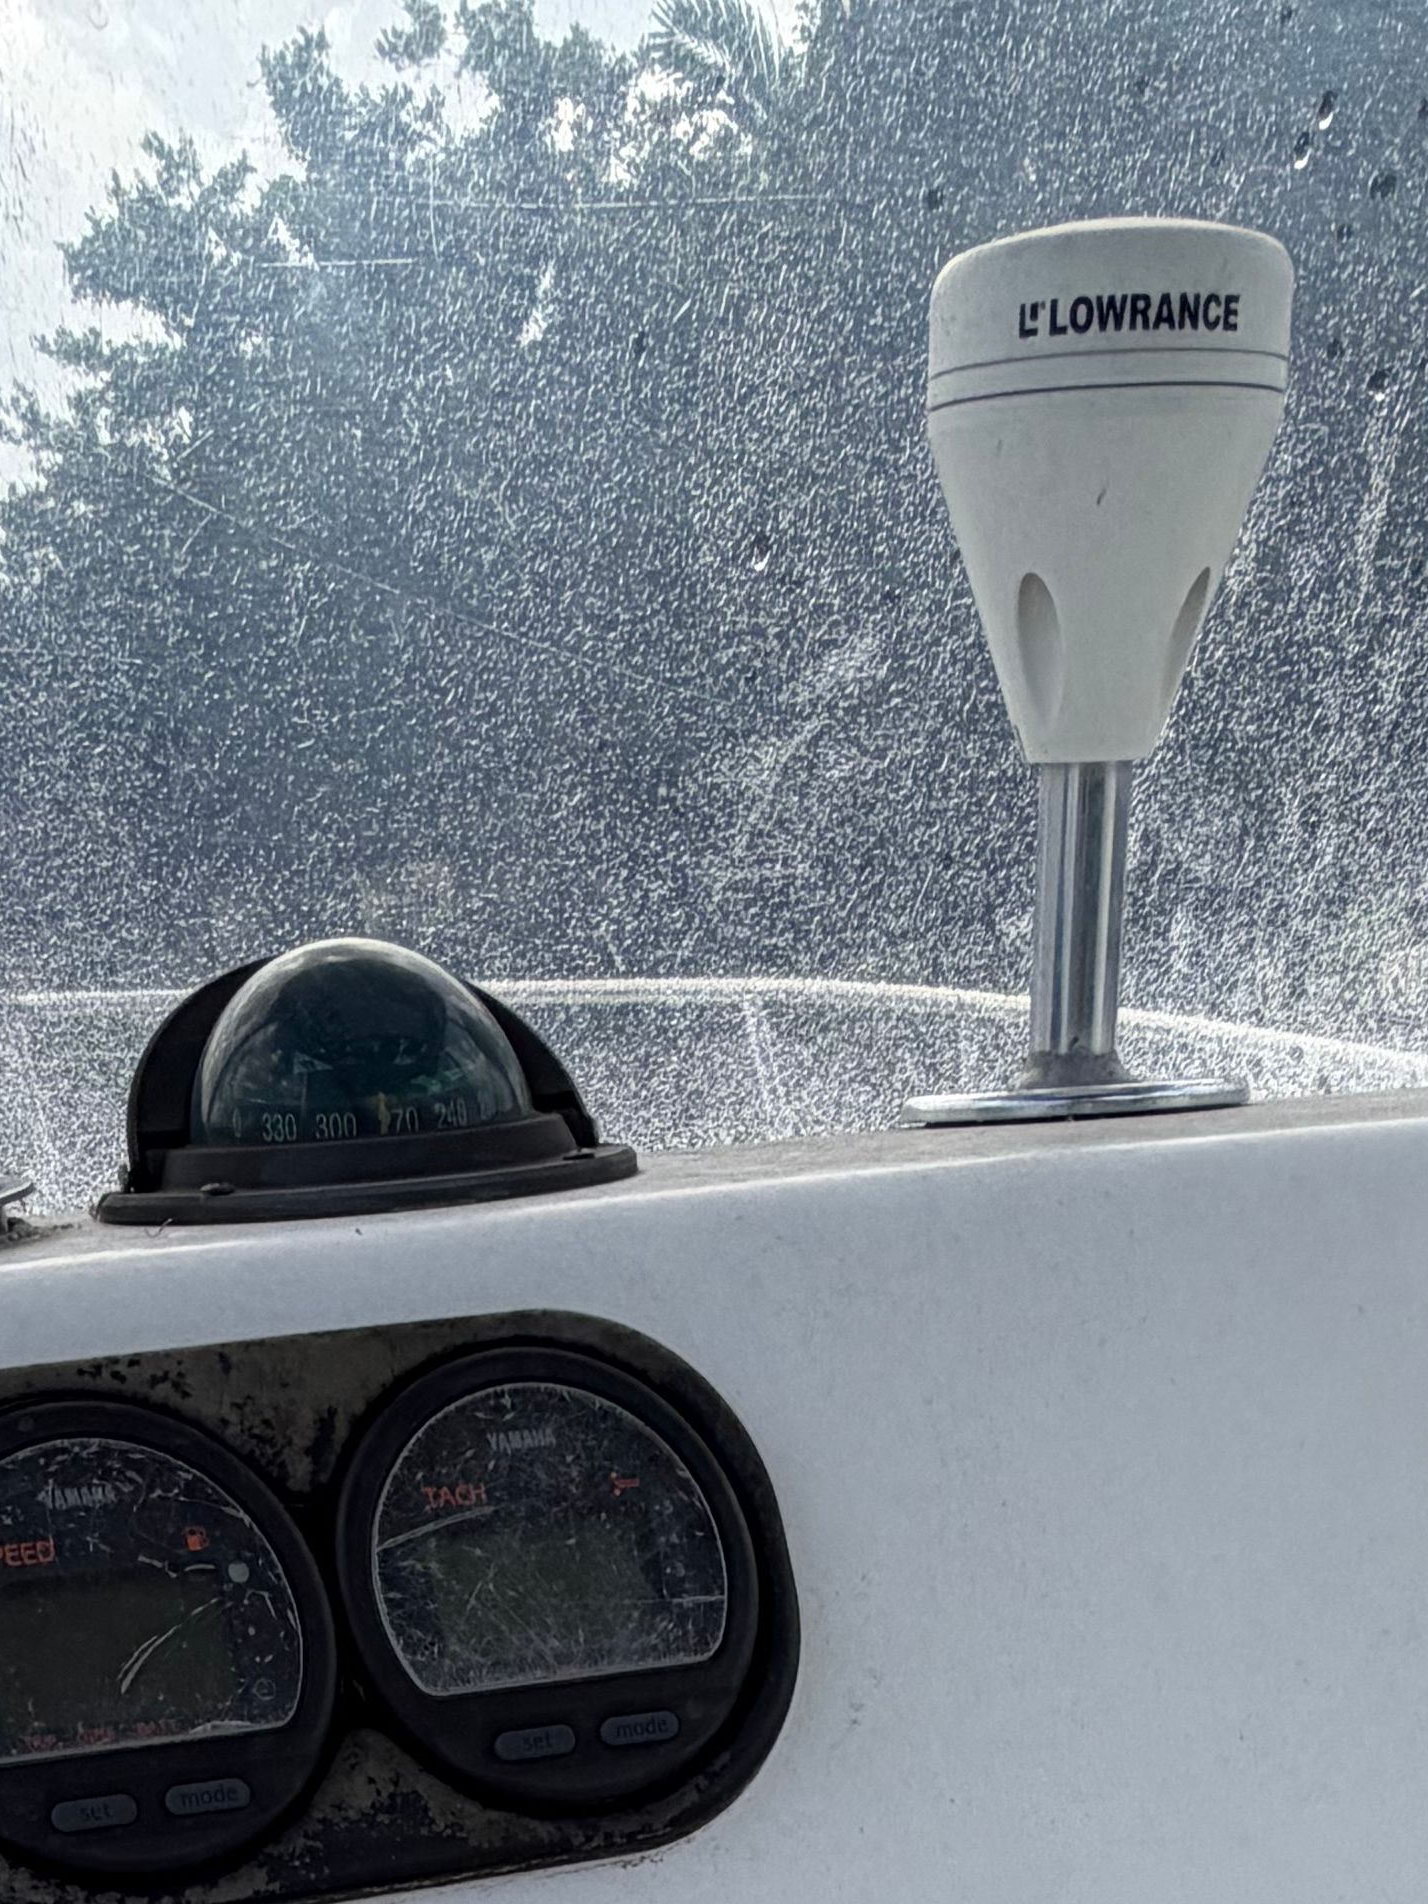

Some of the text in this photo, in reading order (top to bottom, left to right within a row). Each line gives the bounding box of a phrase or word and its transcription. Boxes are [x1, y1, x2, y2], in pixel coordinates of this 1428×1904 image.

[1049, 291, 1241, 336] LOWRANCE
[261, 1112, 298, 1142] 330
[315, 1112, 357, 1139] 300
[386, 1106, 420, 1134] 70
[486, 1427, 557, 1454] YAMAHA
[422, 1482, 487, 1510] TACH
[615, 1714, 669, 1739] mode
[180, 1783, 240, 1808] mode
